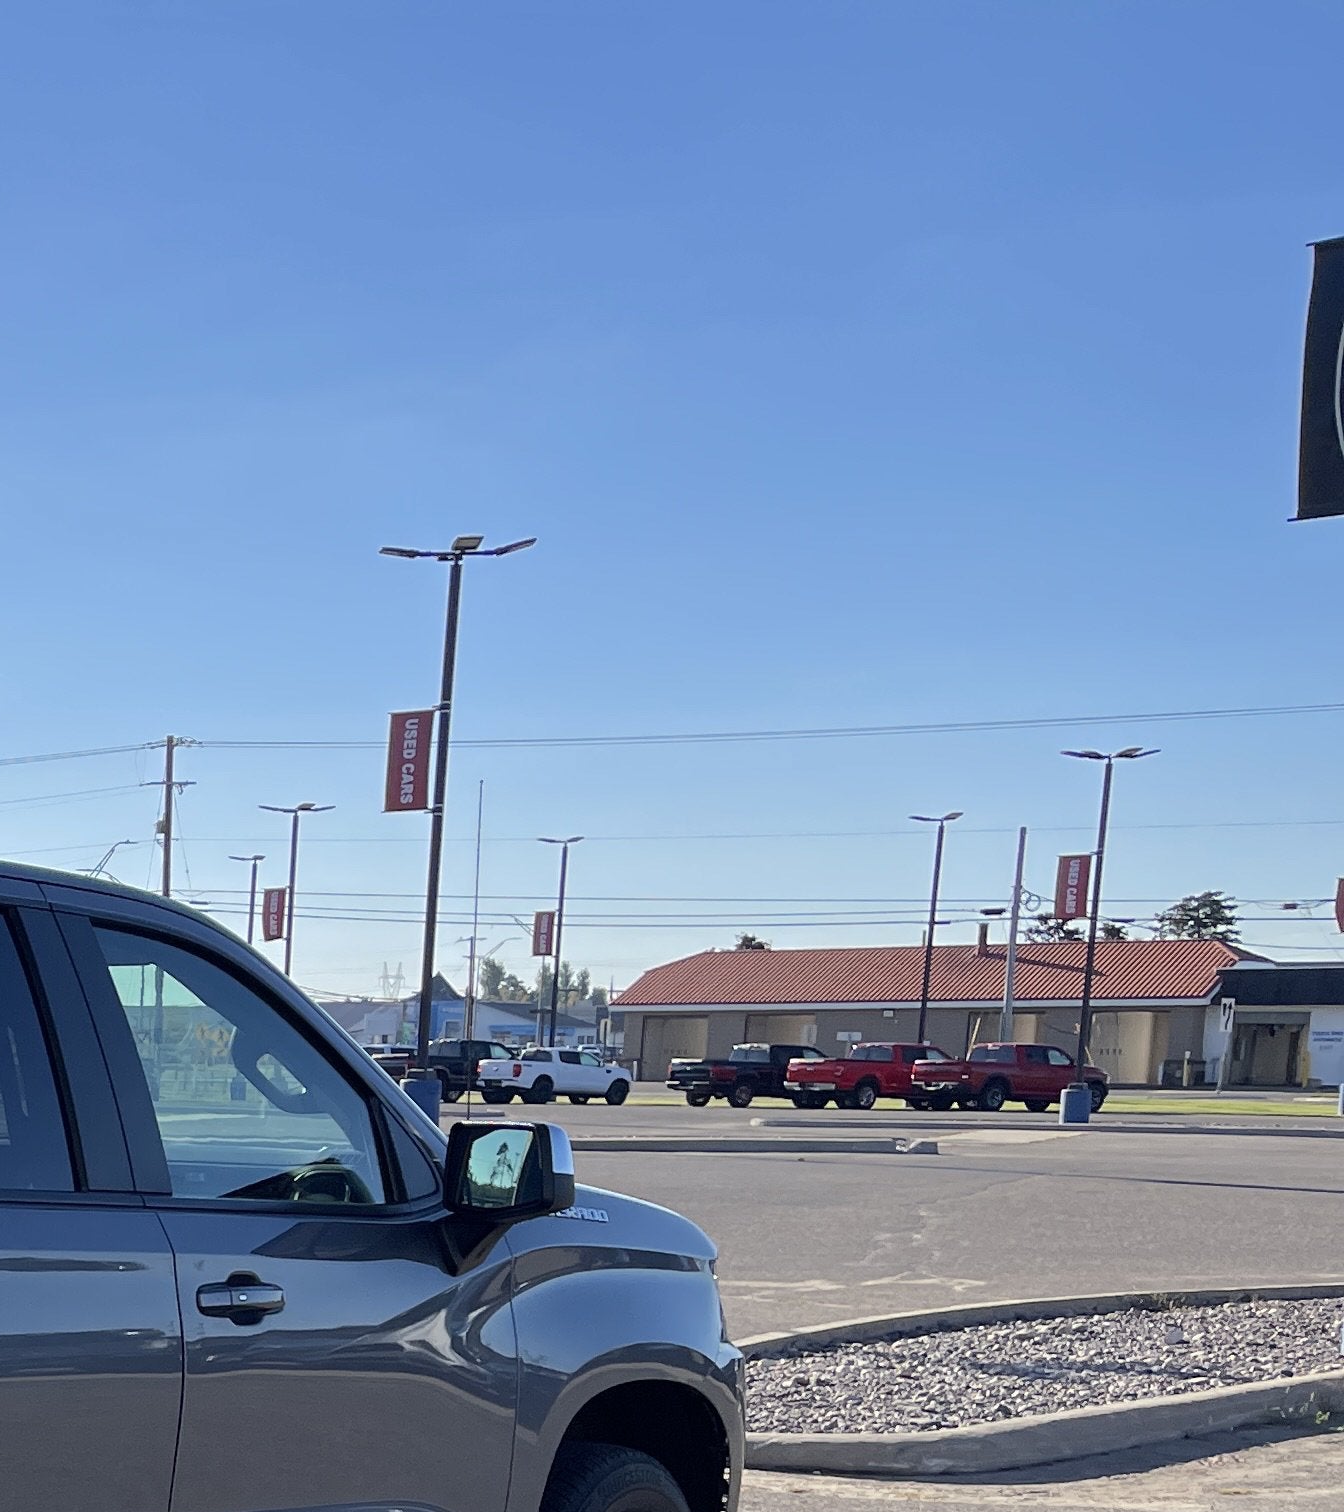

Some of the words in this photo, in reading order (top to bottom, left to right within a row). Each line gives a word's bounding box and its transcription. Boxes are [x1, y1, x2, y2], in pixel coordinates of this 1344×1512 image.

[402, 718, 419, 760] USED
[399, 762, 415, 805] CARS
[1067, 859, 1081, 886] USED
[1065, 887, 1078, 914] CARS
